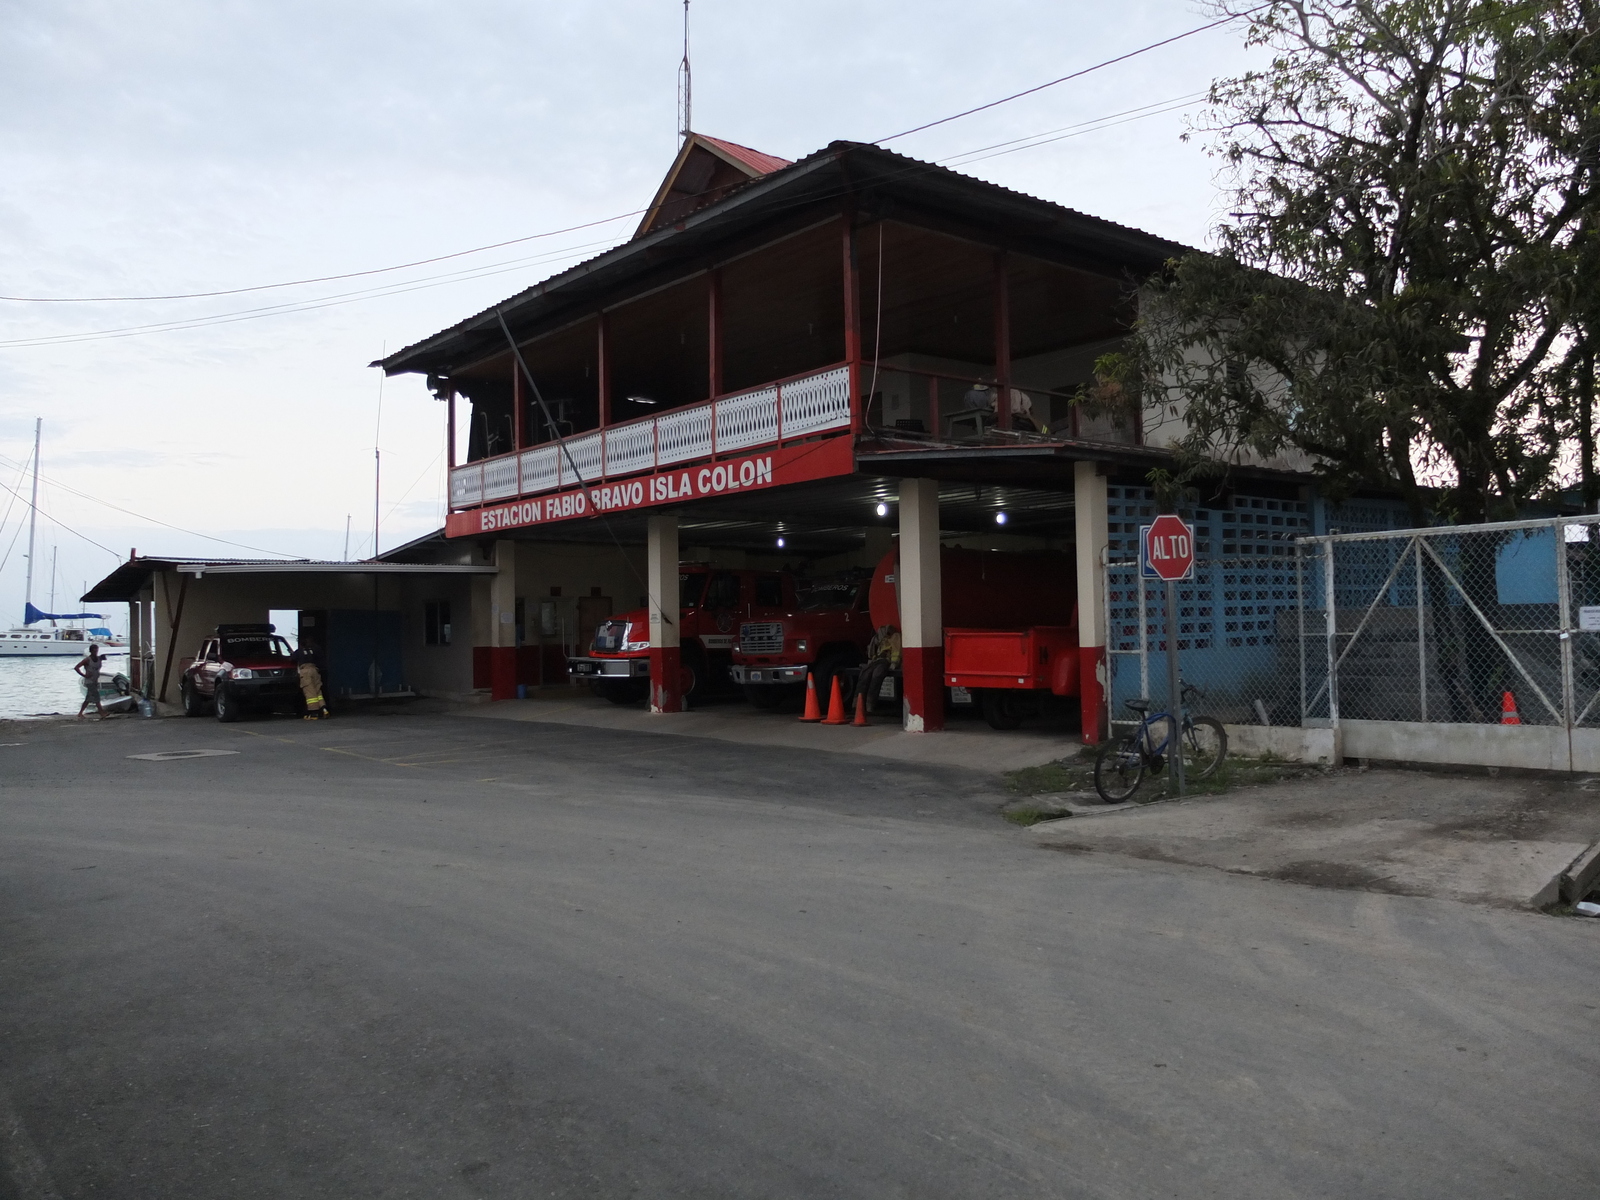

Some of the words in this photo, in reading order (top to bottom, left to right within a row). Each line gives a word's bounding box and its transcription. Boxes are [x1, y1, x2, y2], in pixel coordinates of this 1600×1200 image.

[481, 501, 541, 531] ESTACION
[546, 492, 586, 519] FABIO
[591, 481, 643, 512] BRAVO
[650, 473, 693, 502] ISLA
[697, 457, 772, 494] COLON
[1153, 535, 1188, 560] ALTO
[844, 612, 850, 622] 2
